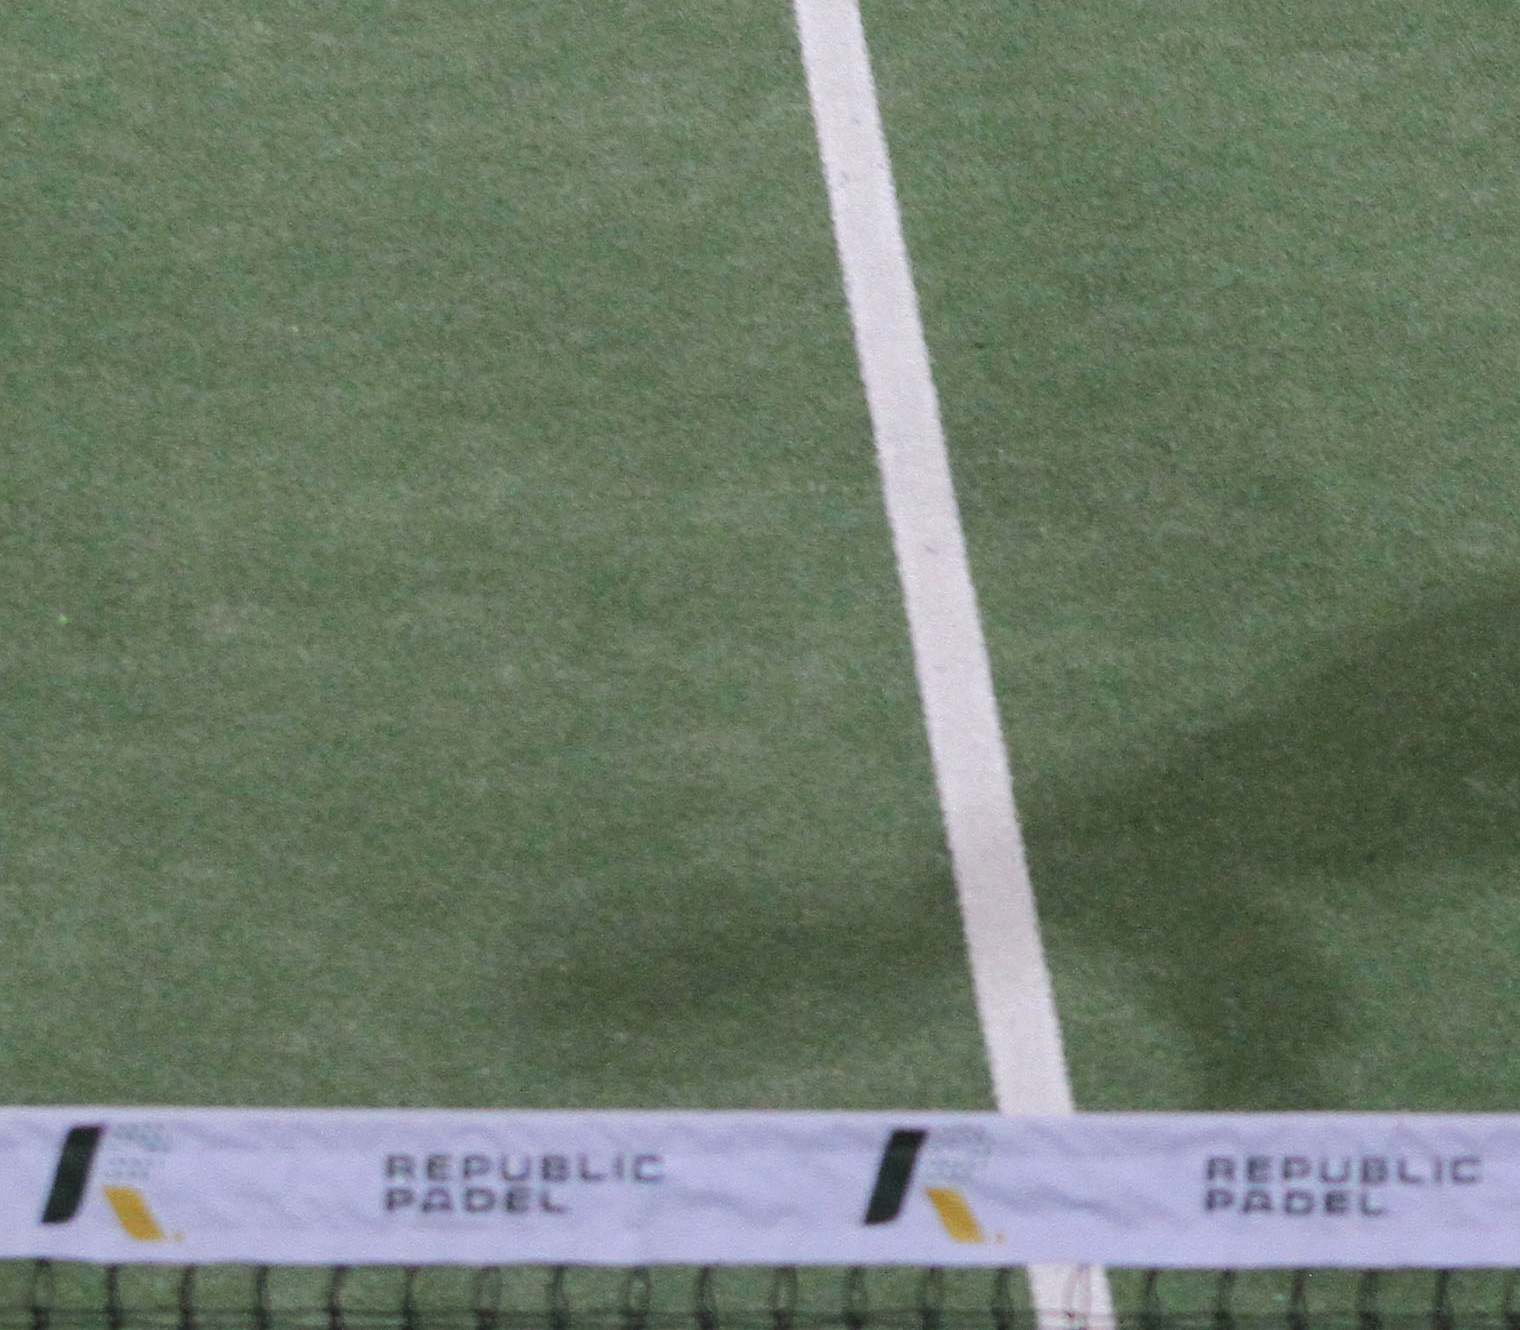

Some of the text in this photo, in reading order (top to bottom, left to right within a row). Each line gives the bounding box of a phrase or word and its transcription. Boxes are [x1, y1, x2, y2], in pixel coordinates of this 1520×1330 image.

[385, 1154, 664, 1182] REPUBLIC
[1206, 1157, 1482, 1184] REPUBLIC
[384, 1186, 568, 1214] PADEL
[1204, 1189, 1385, 1216] PADEL
